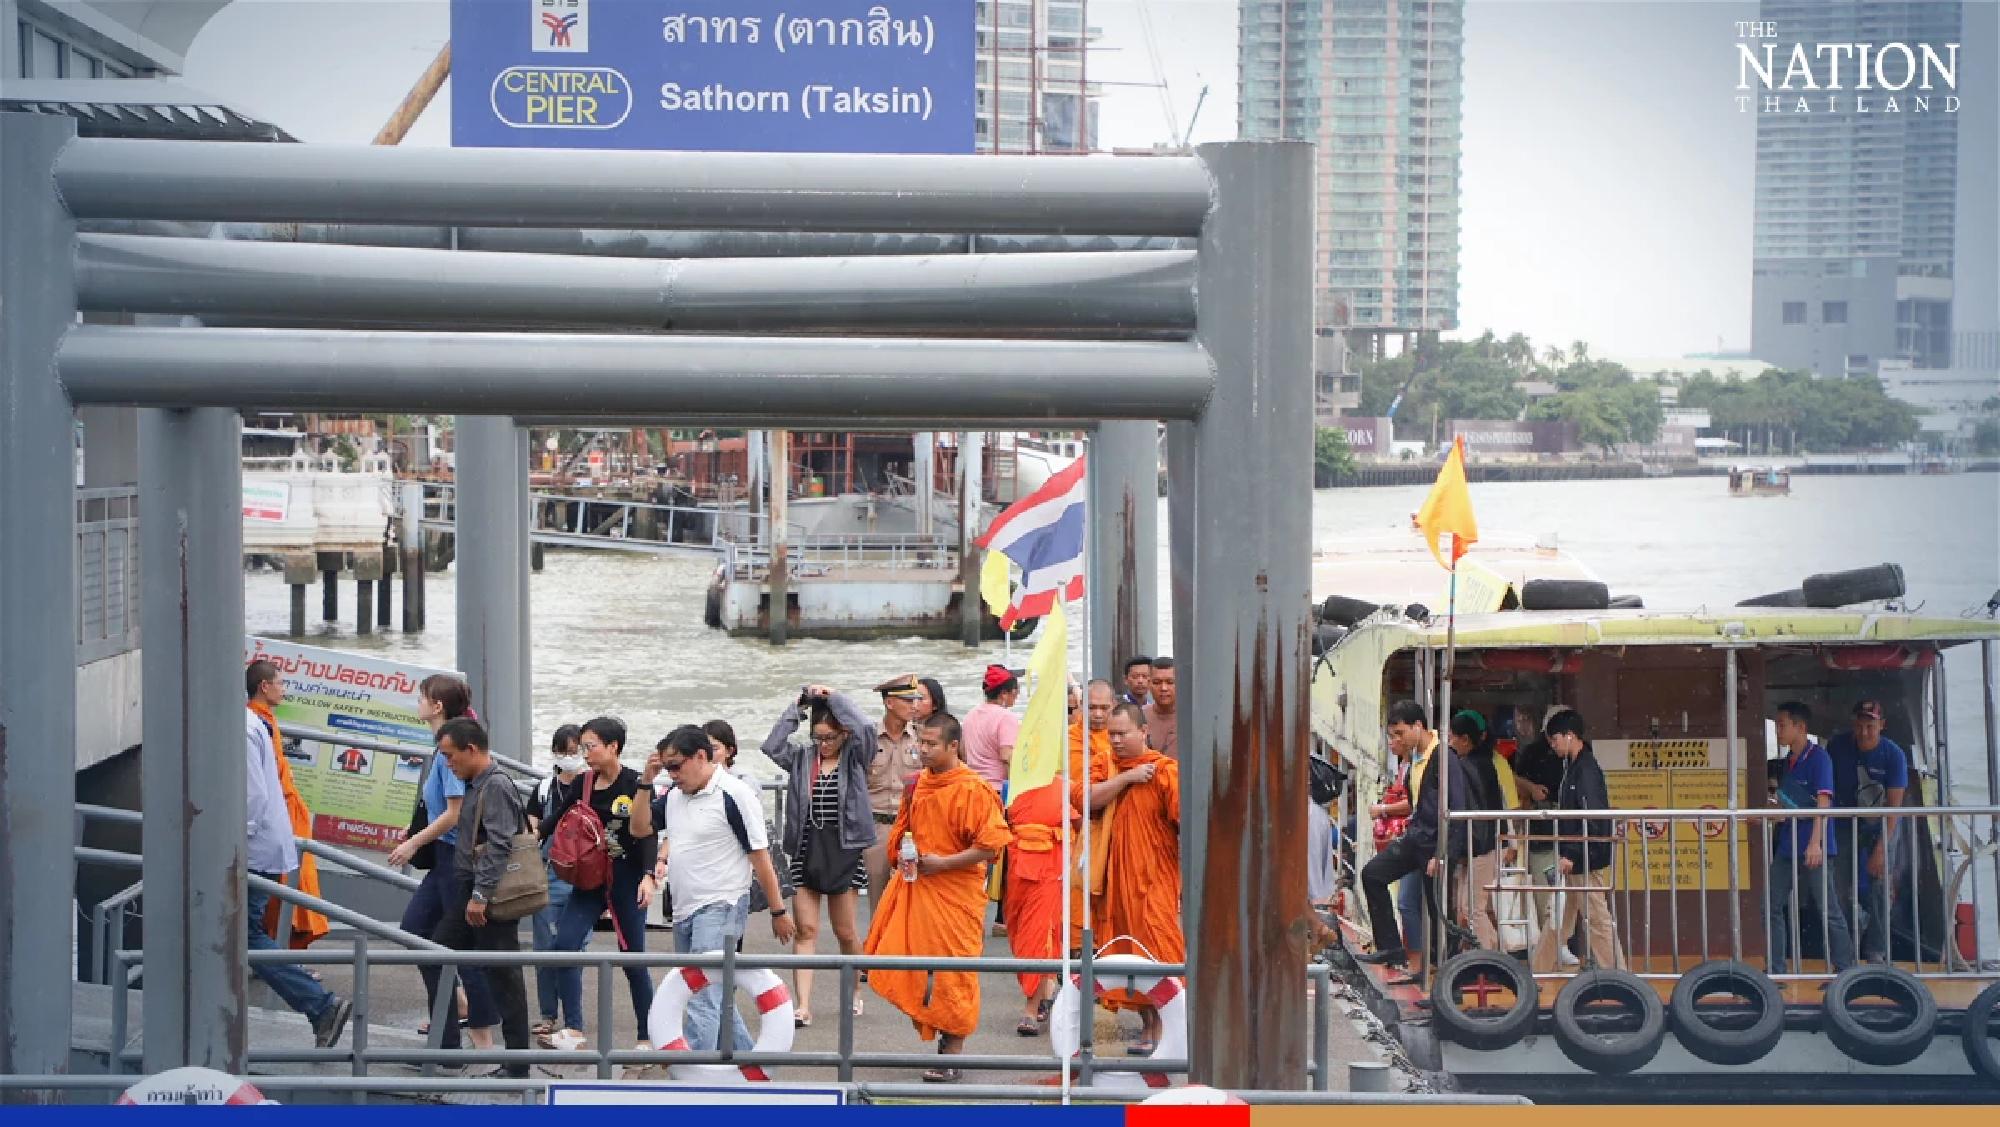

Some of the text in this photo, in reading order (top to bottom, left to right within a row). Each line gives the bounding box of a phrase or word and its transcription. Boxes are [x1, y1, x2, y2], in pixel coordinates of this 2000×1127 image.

[662, 6, 935, 54] สาทร (ตากสิน)
[503, 71, 619, 95] CENTRAL
[527, 97, 598, 124] PIER
[660, 83, 934, 120] Sathorn (Taksin)
[297, 697, 332, 709] FOLLOW
[333, 703, 365, 715] SAFETY
[1631, 860, 1713, 870] Plese wlk insde
[147, 1083, 223, 1102] กรมเ้าท่า
